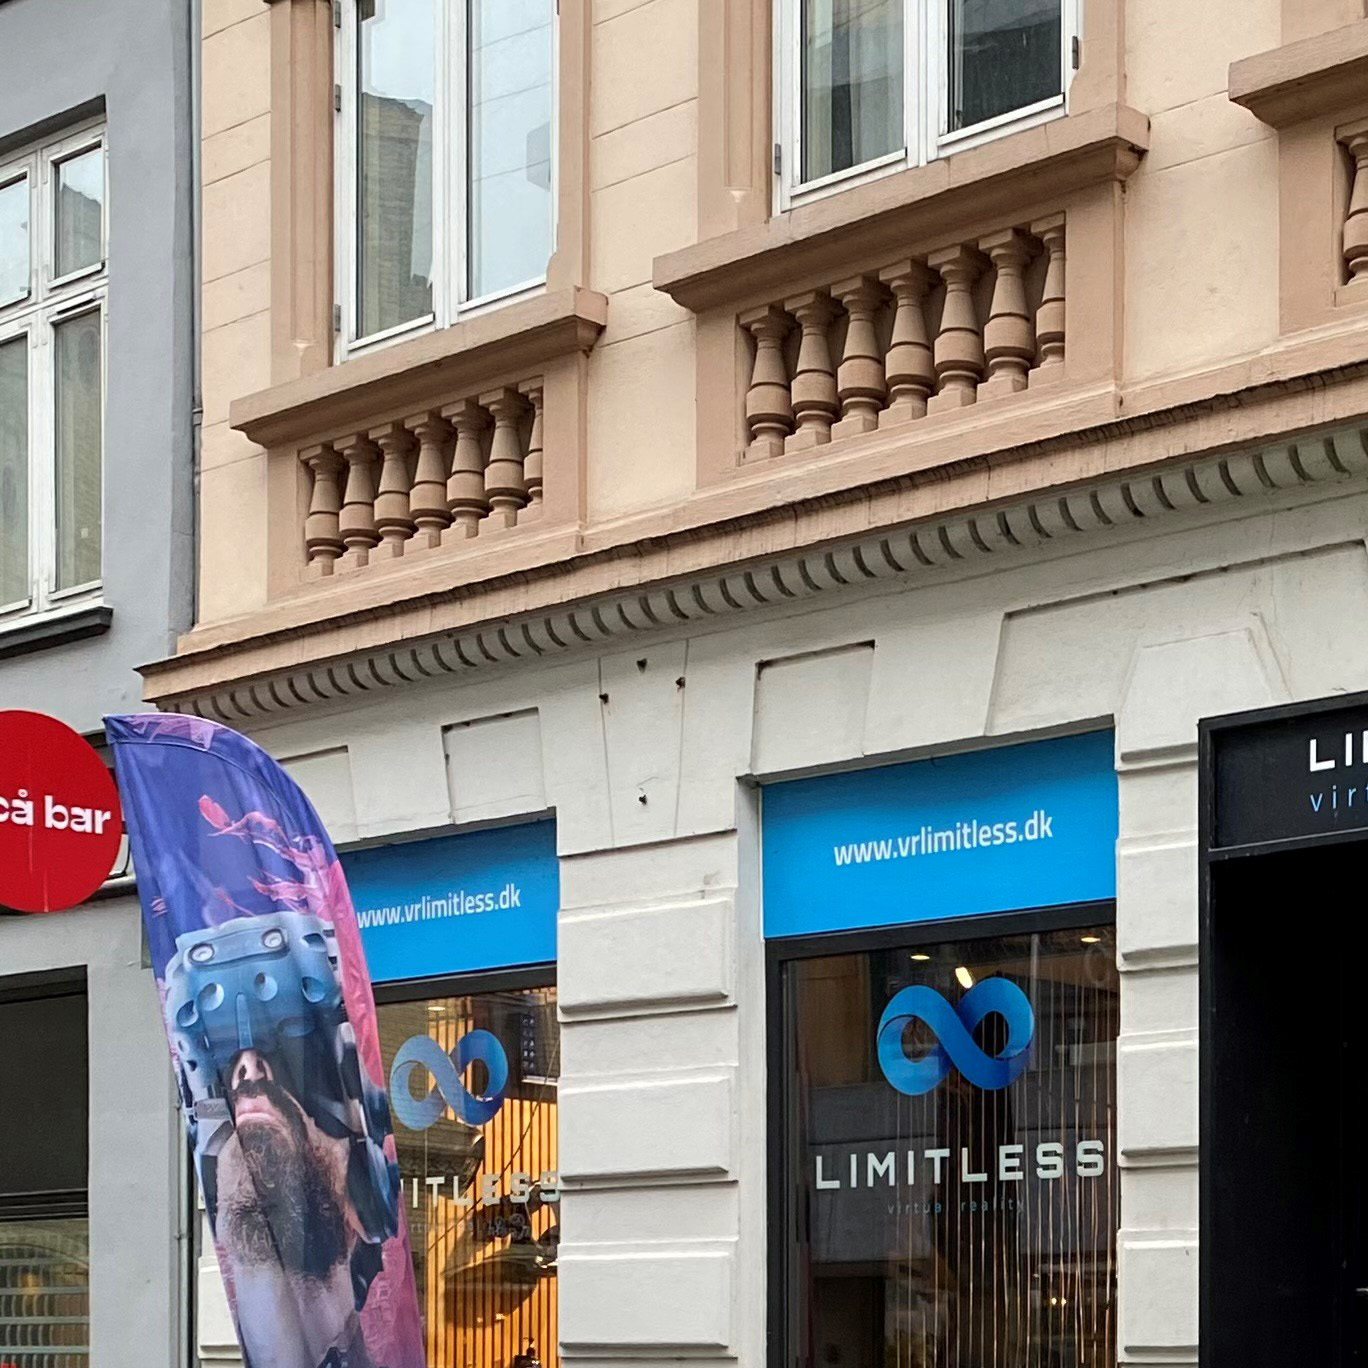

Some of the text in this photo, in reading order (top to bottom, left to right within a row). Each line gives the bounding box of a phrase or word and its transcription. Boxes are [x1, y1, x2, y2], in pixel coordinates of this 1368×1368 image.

[44, 795, 111, 834] bar
[833, 810, 1053, 866] www.vrlimitless.dk
[357, 883, 521, 928] www.vrlimitless.dk
[816, 1140, 1104, 1190] LIMITLESS
[400, 1170, 560, 1208] ITLESS
